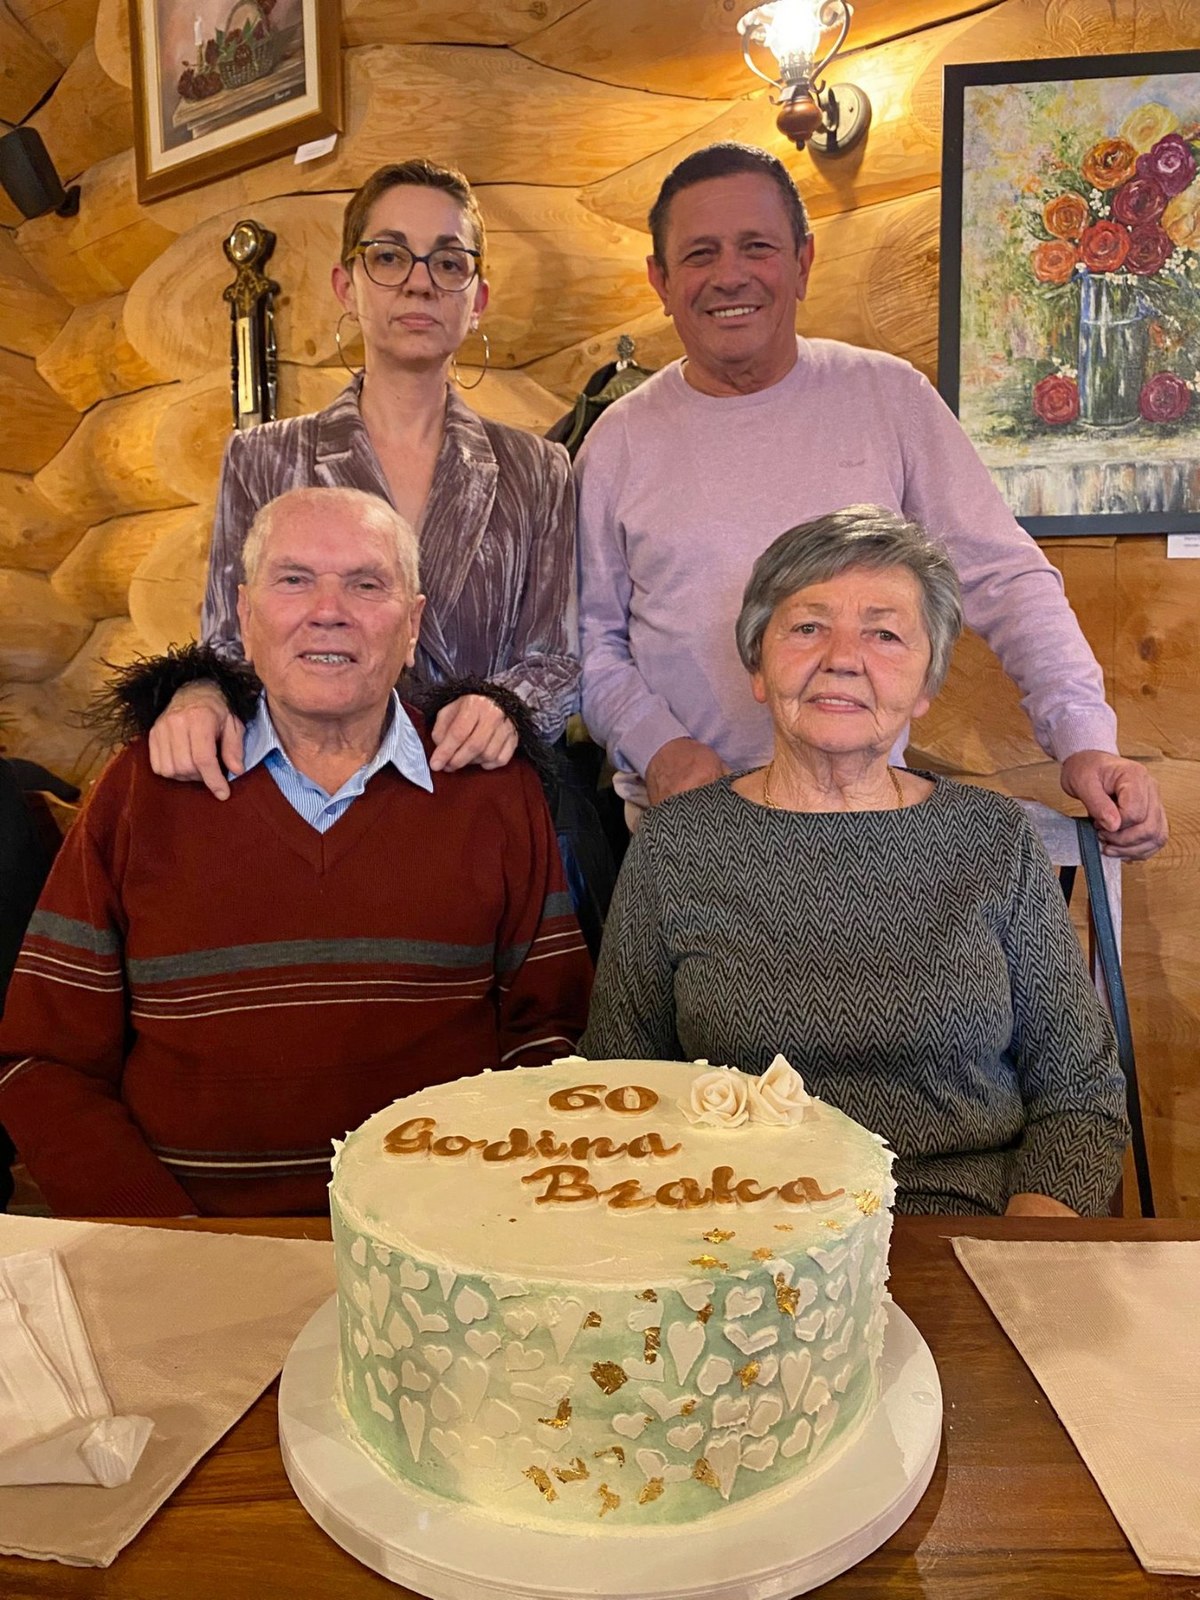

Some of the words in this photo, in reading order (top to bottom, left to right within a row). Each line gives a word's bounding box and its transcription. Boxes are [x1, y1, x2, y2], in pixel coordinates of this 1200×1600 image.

[548, 1084, 659, 1114] 60
[383, 1117, 683, 1161] Godina
[520, 1164, 845, 1208] Braka
